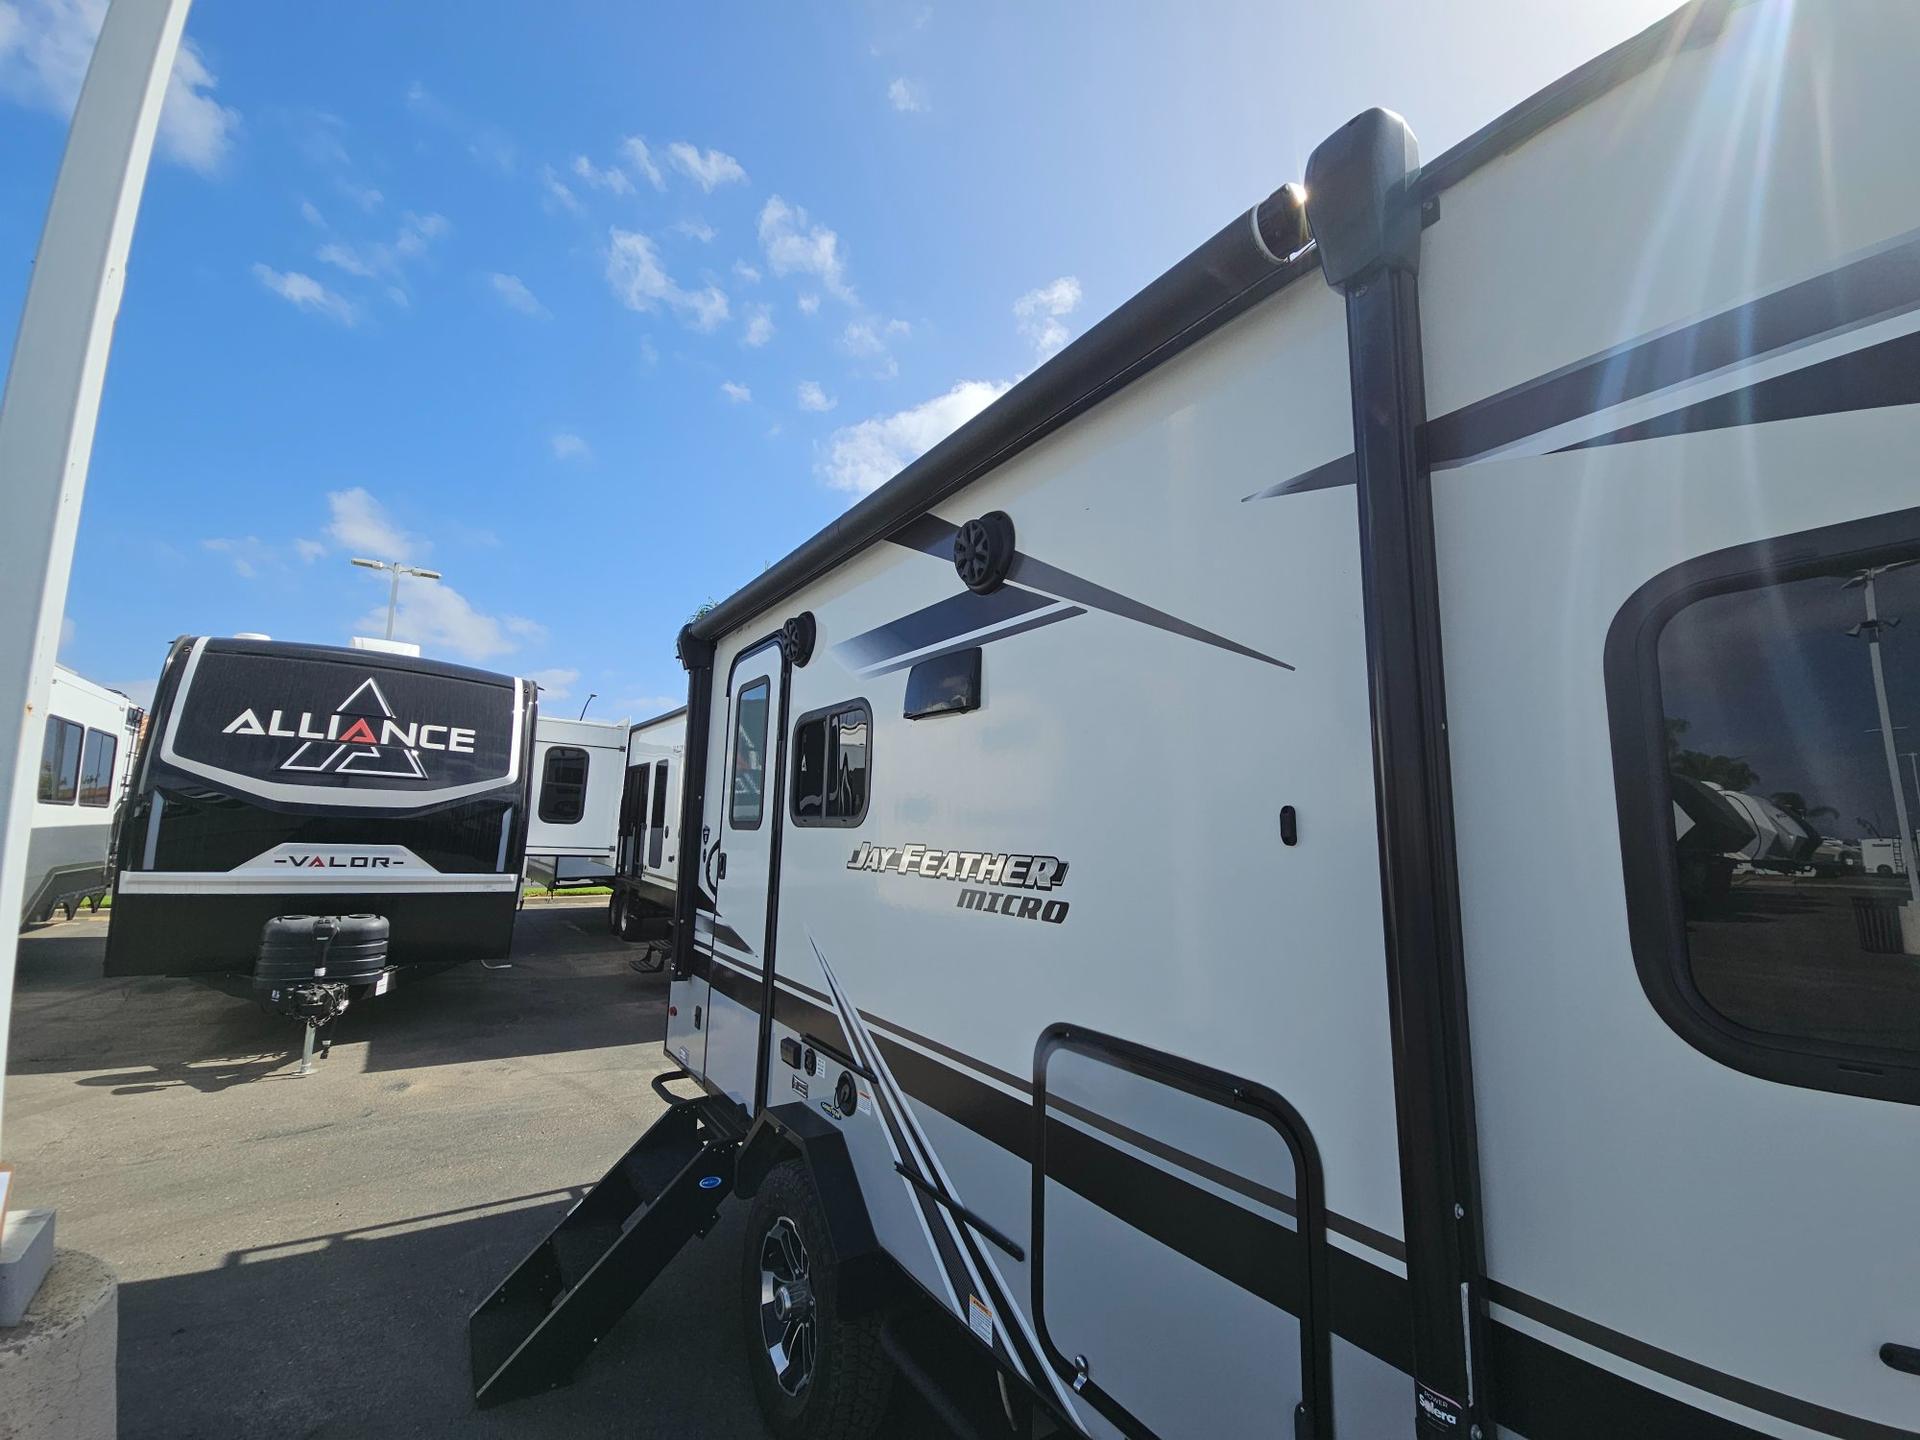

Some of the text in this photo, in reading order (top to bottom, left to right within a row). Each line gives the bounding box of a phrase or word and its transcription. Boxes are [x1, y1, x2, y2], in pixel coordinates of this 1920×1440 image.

[222, 708, 476, 753] ALLIANCE
[847, 841, 1060, 891] JAY FEATHER
[956, 888, 1070, 924] MICRO
